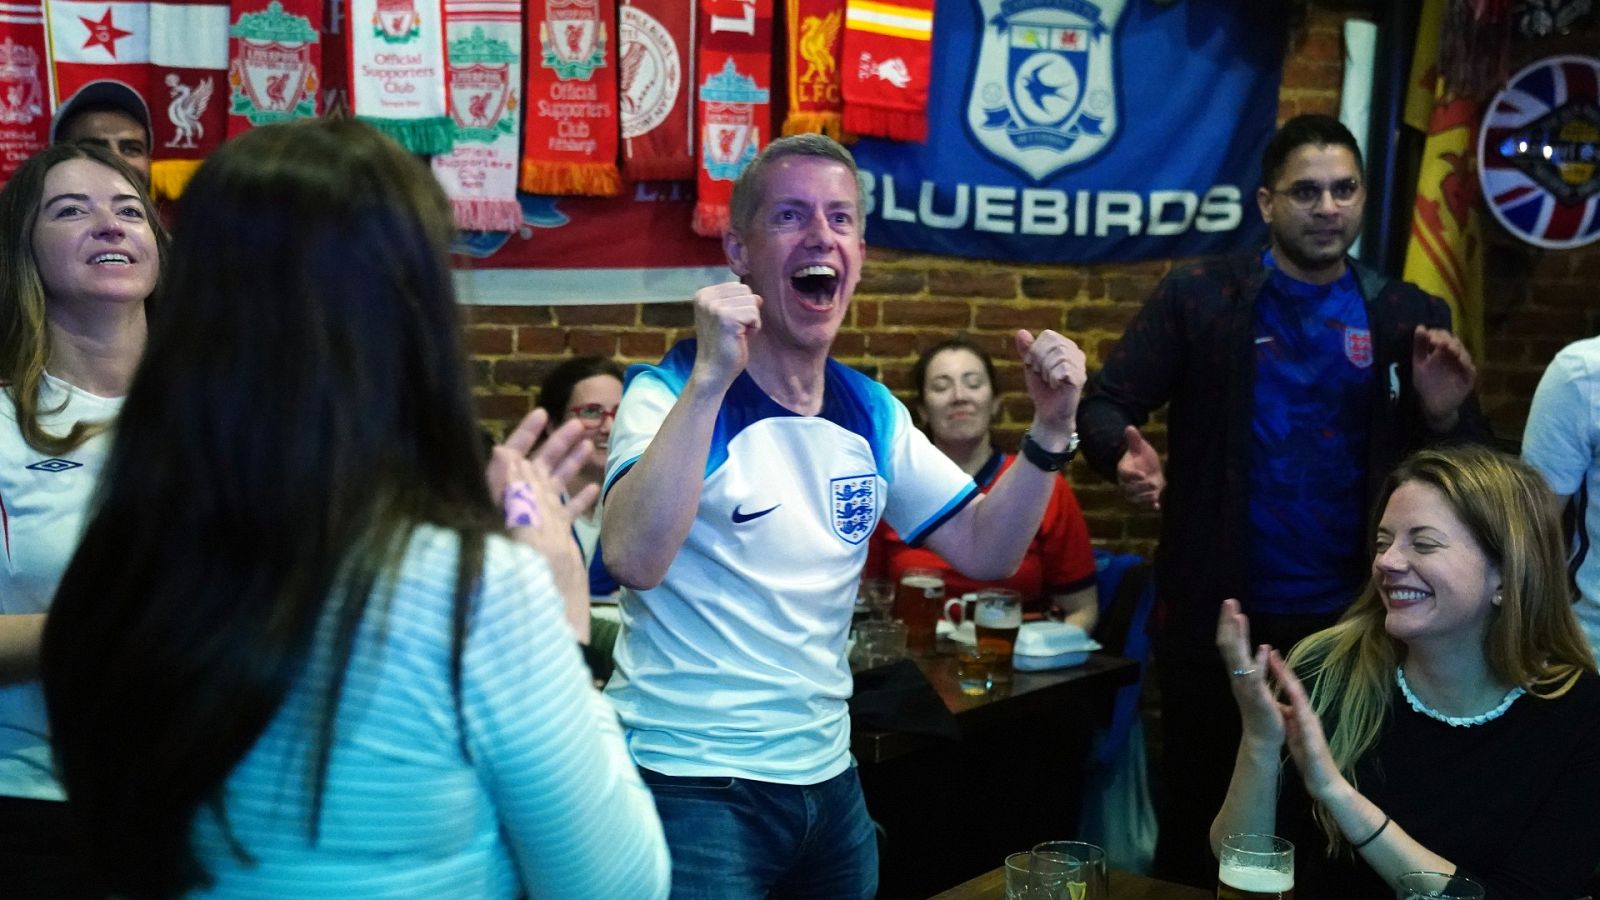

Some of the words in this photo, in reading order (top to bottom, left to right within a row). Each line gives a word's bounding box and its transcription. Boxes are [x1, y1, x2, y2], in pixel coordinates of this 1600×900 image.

[374, 53, 421, 66] Official
[361, 65, 435, 82] Supporters
[384, 82, 416, 94] Club
[551, 82, 598, 101] Official
[537, 99, 612, 121] Supporters
[557, 121, 590, 138] Club
